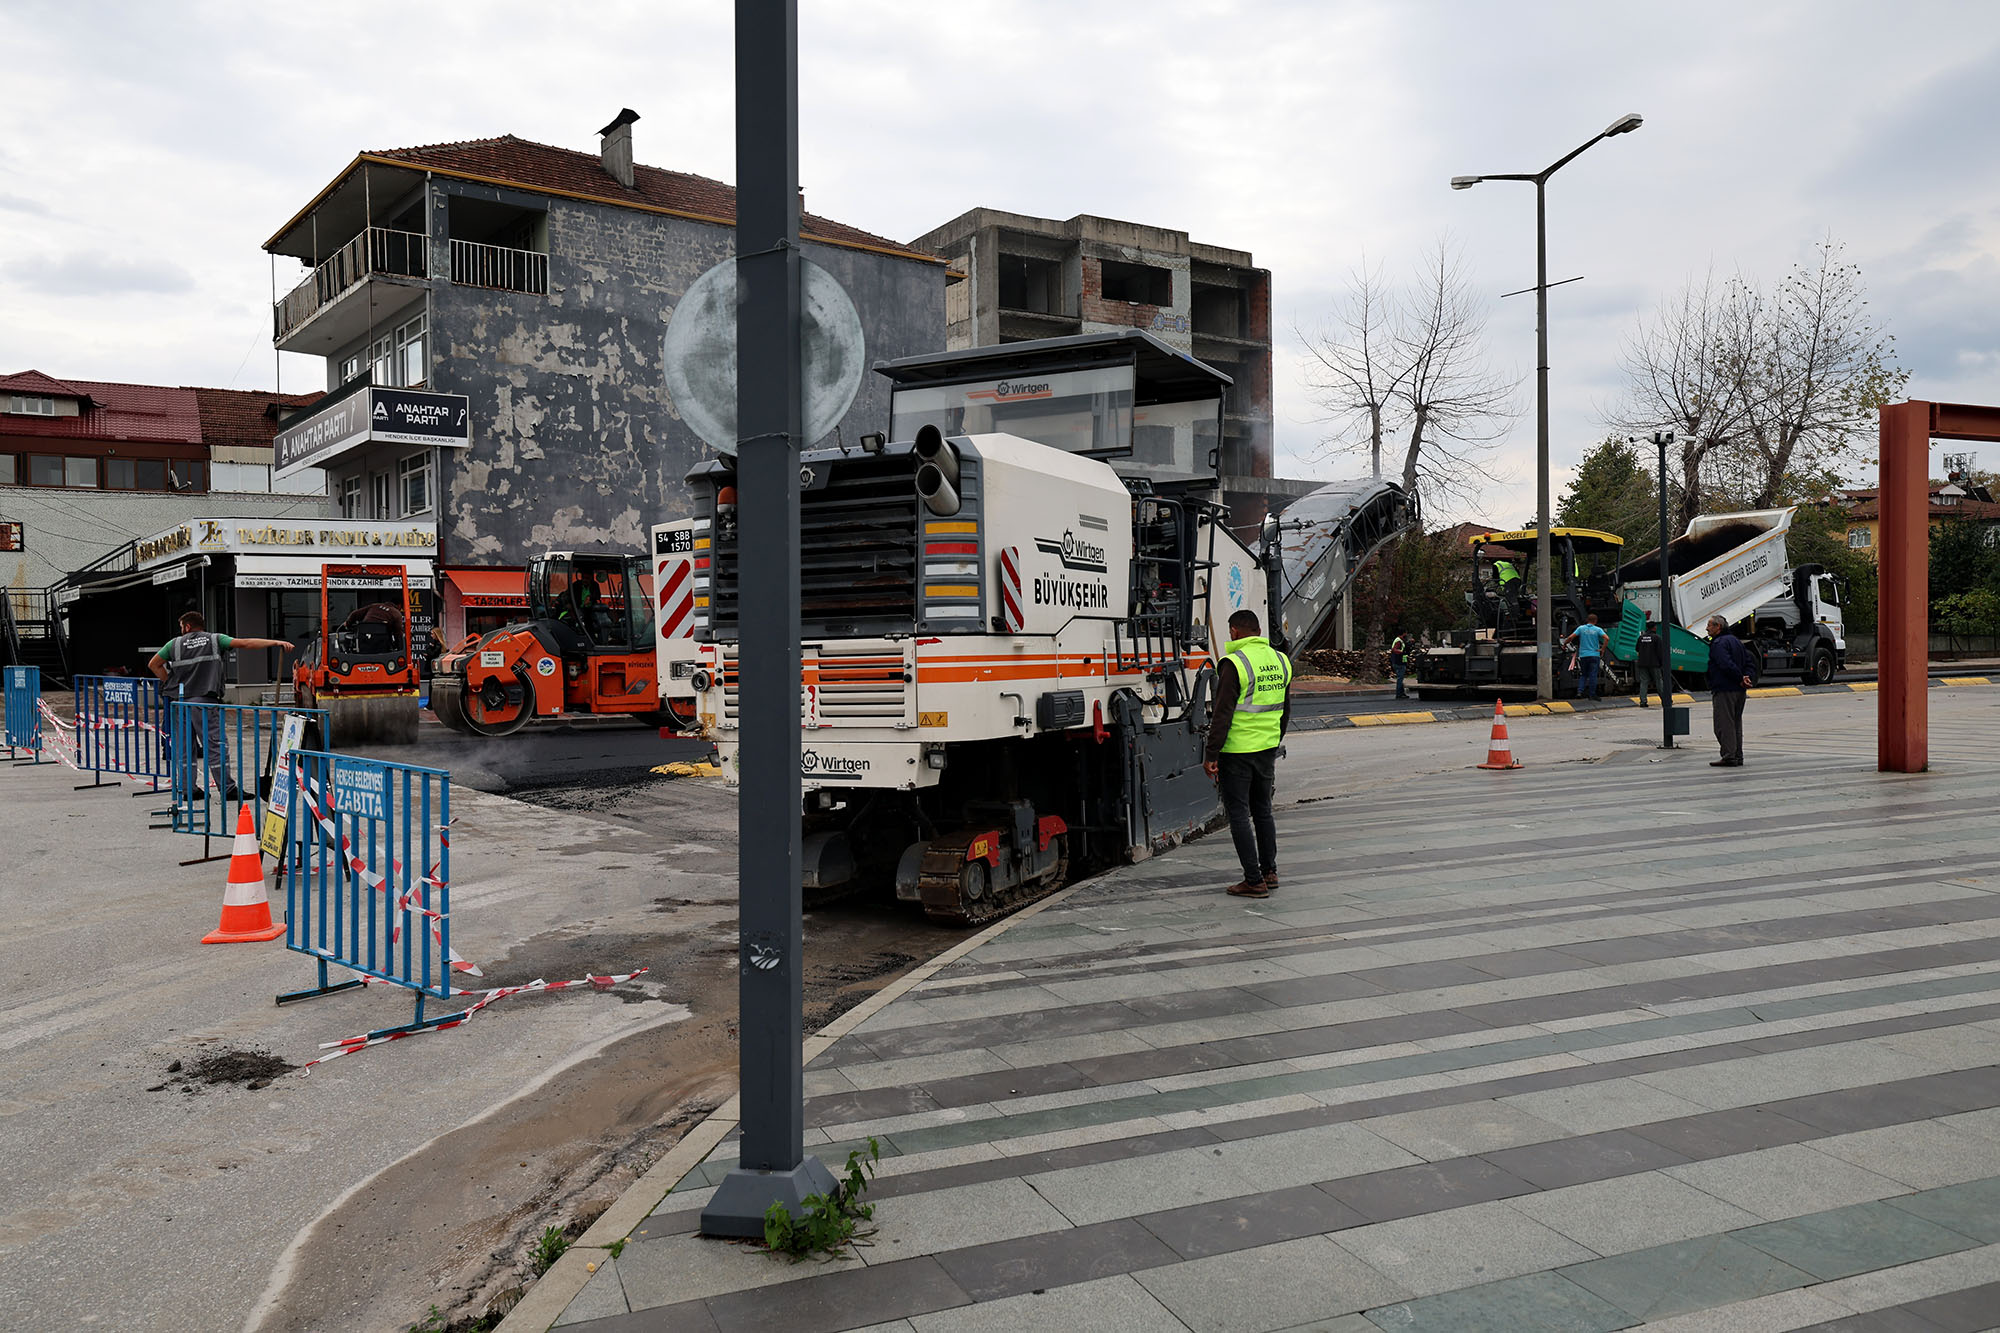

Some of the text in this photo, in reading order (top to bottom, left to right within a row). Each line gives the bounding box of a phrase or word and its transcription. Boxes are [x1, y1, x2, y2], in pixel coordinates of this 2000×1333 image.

[1011, 383, 1049, 394] Wirtgen
[395, 402, 449, 417] ANAHTAR
[290, 422, 323, 458] ANAHTAR
[236, 524, 435, 547] TAZİMLER FINDIK & ZAHİRE
[658, 531, 690, 542] 54 SBB
[1502, 532, 1527, 540] VÖGELE
[671, 541, 691, 552] 1570
[1075, 540, 1105, 563] Wirtgen
[1700, 550, 1768, 599] SAKARYA BÜYÜKŞEHİR BELEDİYESİ
[1034, 572, 1108, 610] BÜYÜKŞEHİR
[105, 691, 133, 703] ZABITA
[821, 757, 870, 773] Wirtgen
[336, 768, 383, 792] HENDEK BELEDİYESİ
[336, 788, 383, 817] ZABITA
